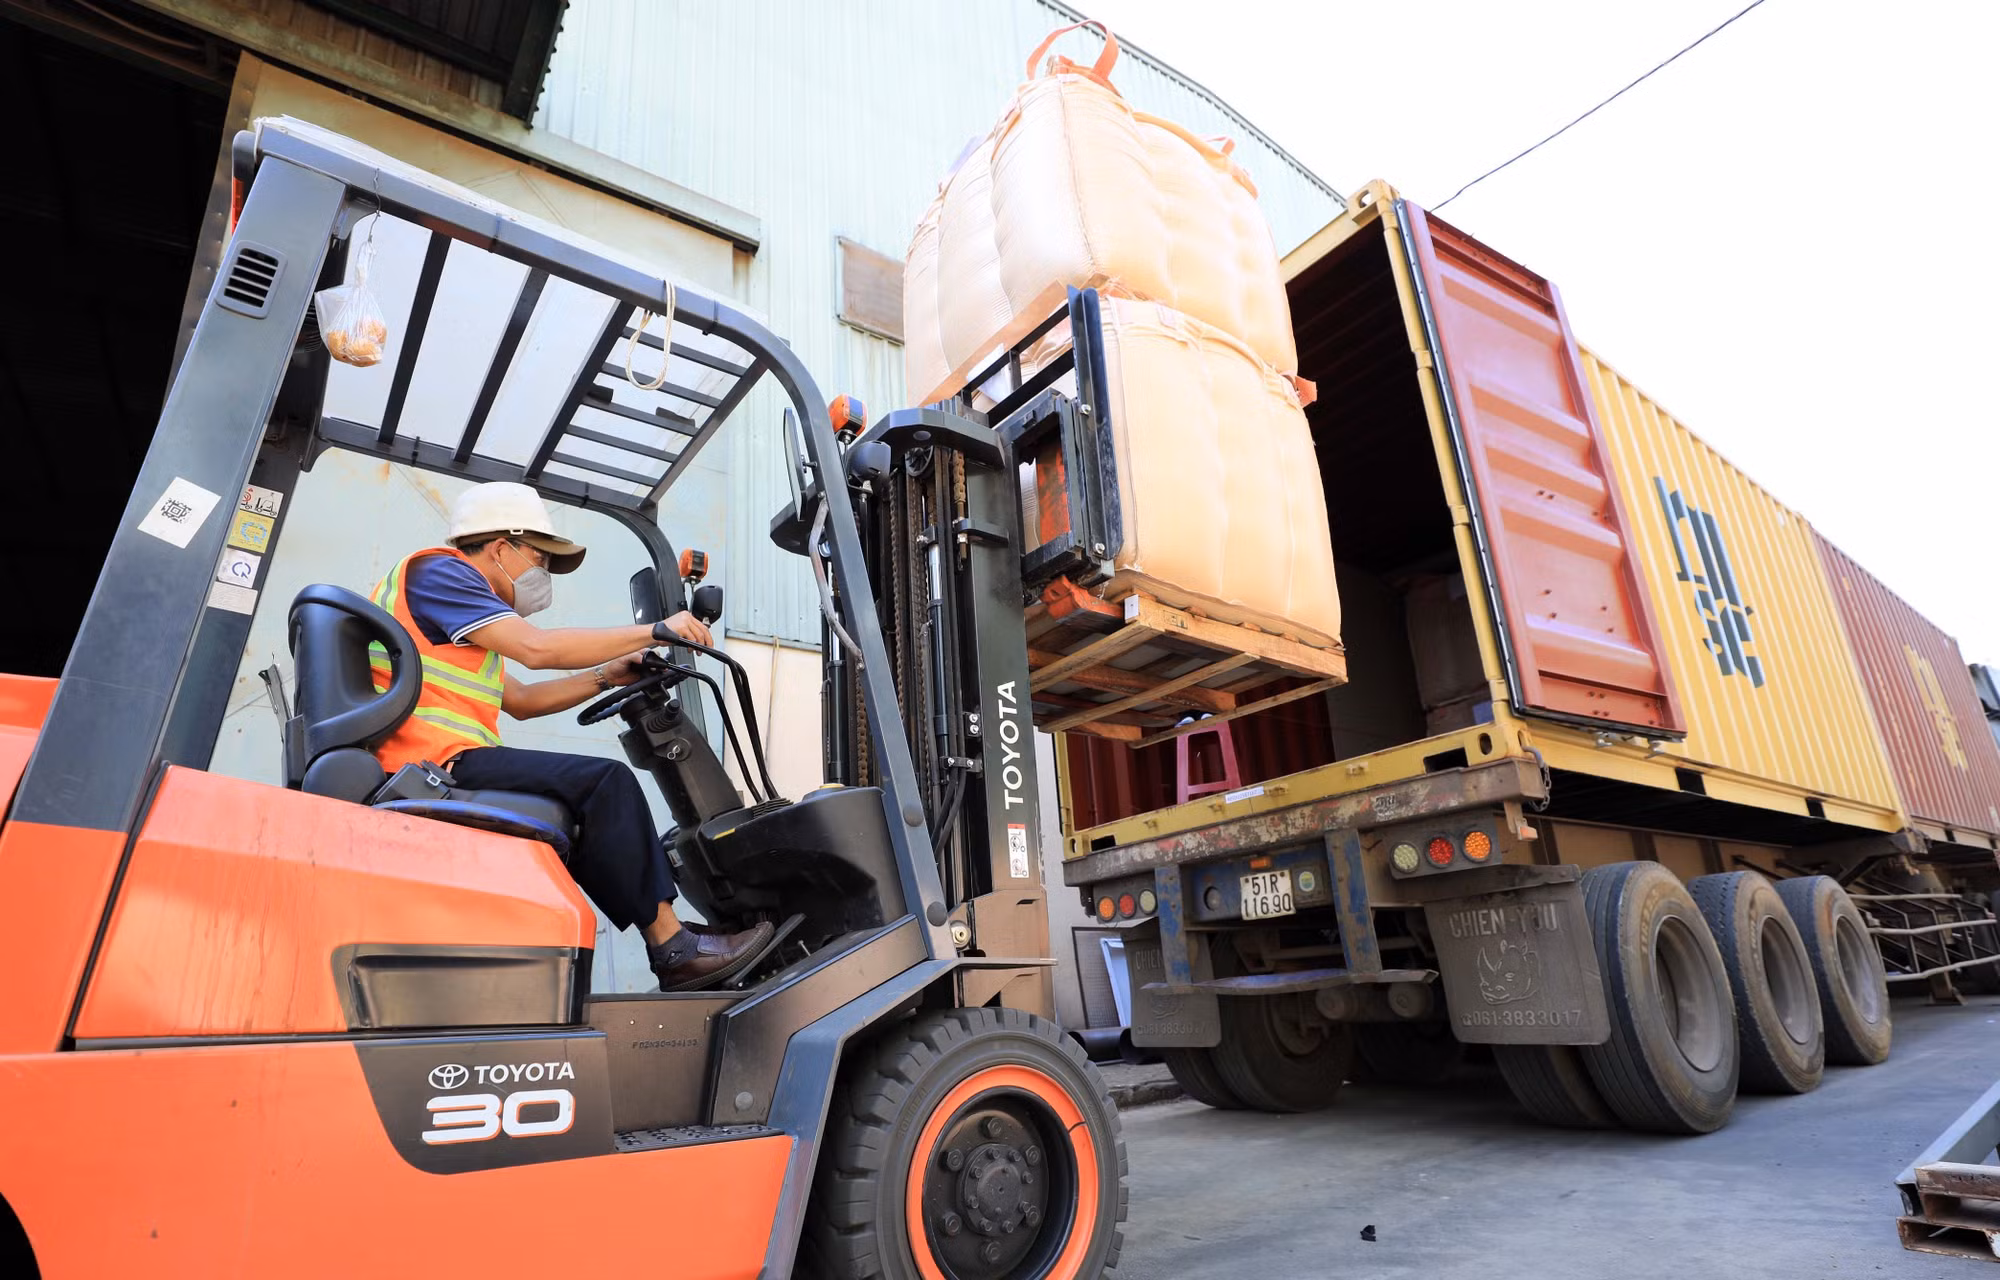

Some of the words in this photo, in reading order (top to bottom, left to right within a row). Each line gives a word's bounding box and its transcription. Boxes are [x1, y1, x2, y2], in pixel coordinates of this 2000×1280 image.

[997, 680, 1024, 810] TOYOTA
[1251, 873, 1279, 896] 51R
[1243, 893, 1292, 918] 116.90
[473, 1061, 576, 1085] TOYOTA
[421, 1088, 577, 1146] 30
